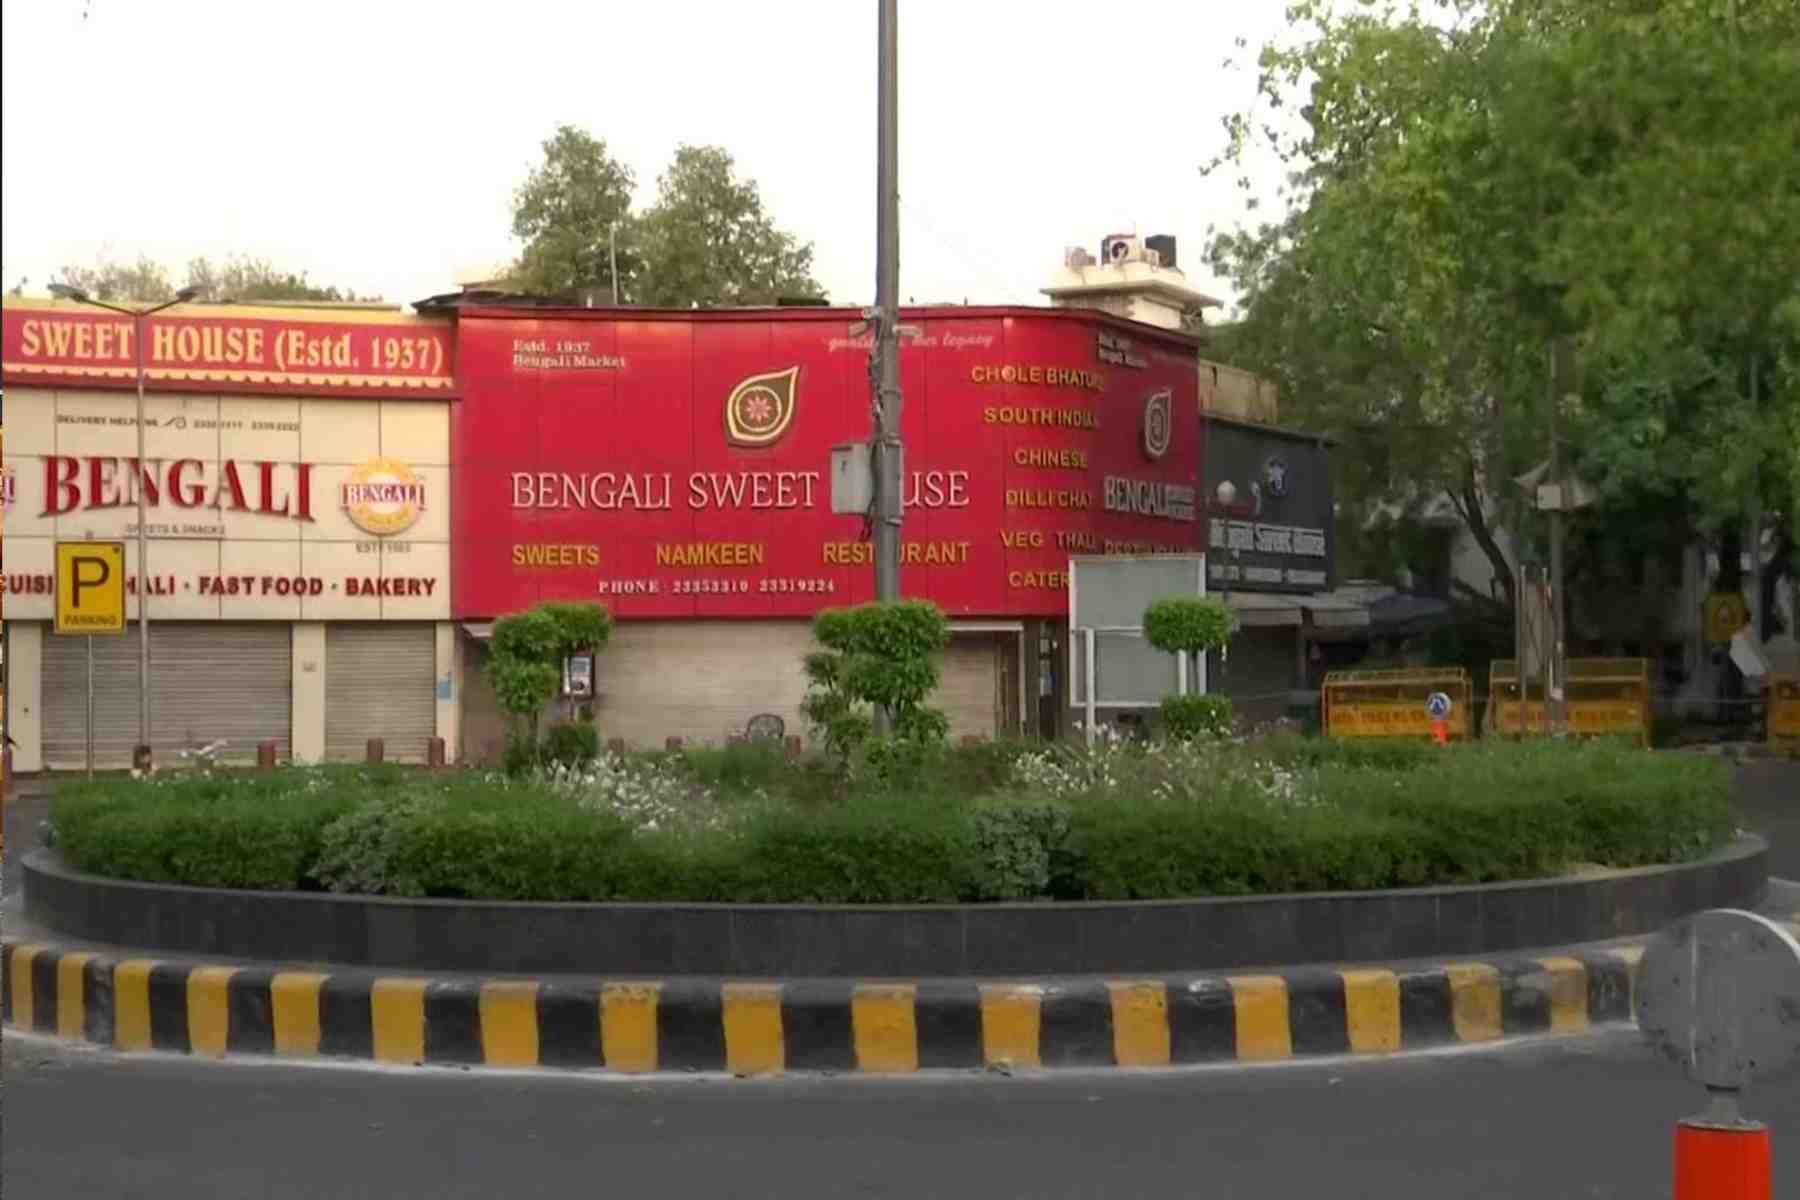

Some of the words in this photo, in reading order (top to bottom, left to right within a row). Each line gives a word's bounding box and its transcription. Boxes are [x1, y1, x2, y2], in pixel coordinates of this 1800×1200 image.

[21, 319, 134, 360] SWEET
[152, 324, 265, 364] HOUSE
[274, 329, 359, 370] (Estd.
[370, 336, 444, 375] 1937)
[971, 365, 1041, 383] CHOLE
[1046, 368, 1103, 389] BHATU
[984, 407, 1052, 424] SOUTH
[1014, 448, 1088, 468] CHINESE
[38, 455, 316, 523] BENGALI
[512, 472, 672, 509] BENGALI
[689, 471, 819, 509] SWEET
[1006, 488, 1053, 507] DILLI
[1058, 490, 1092, 510] CHA
[1000, 530, 1045, 548] VEG
[512, 543, 600, 566] SWEETS
[656, 543, 764, 566] NAMKEEN
[823, 541, 970, 564] RESTRANT
[72, 556, 110, 608] P
[199, 576, 257, 595] FAST
[262, 577, 323, 596] FOOD
[346, 577, 437, 597] BAKERY
[599, 580, 658, 593] PHONE
[1008, 570, 1071, 590] CATER
